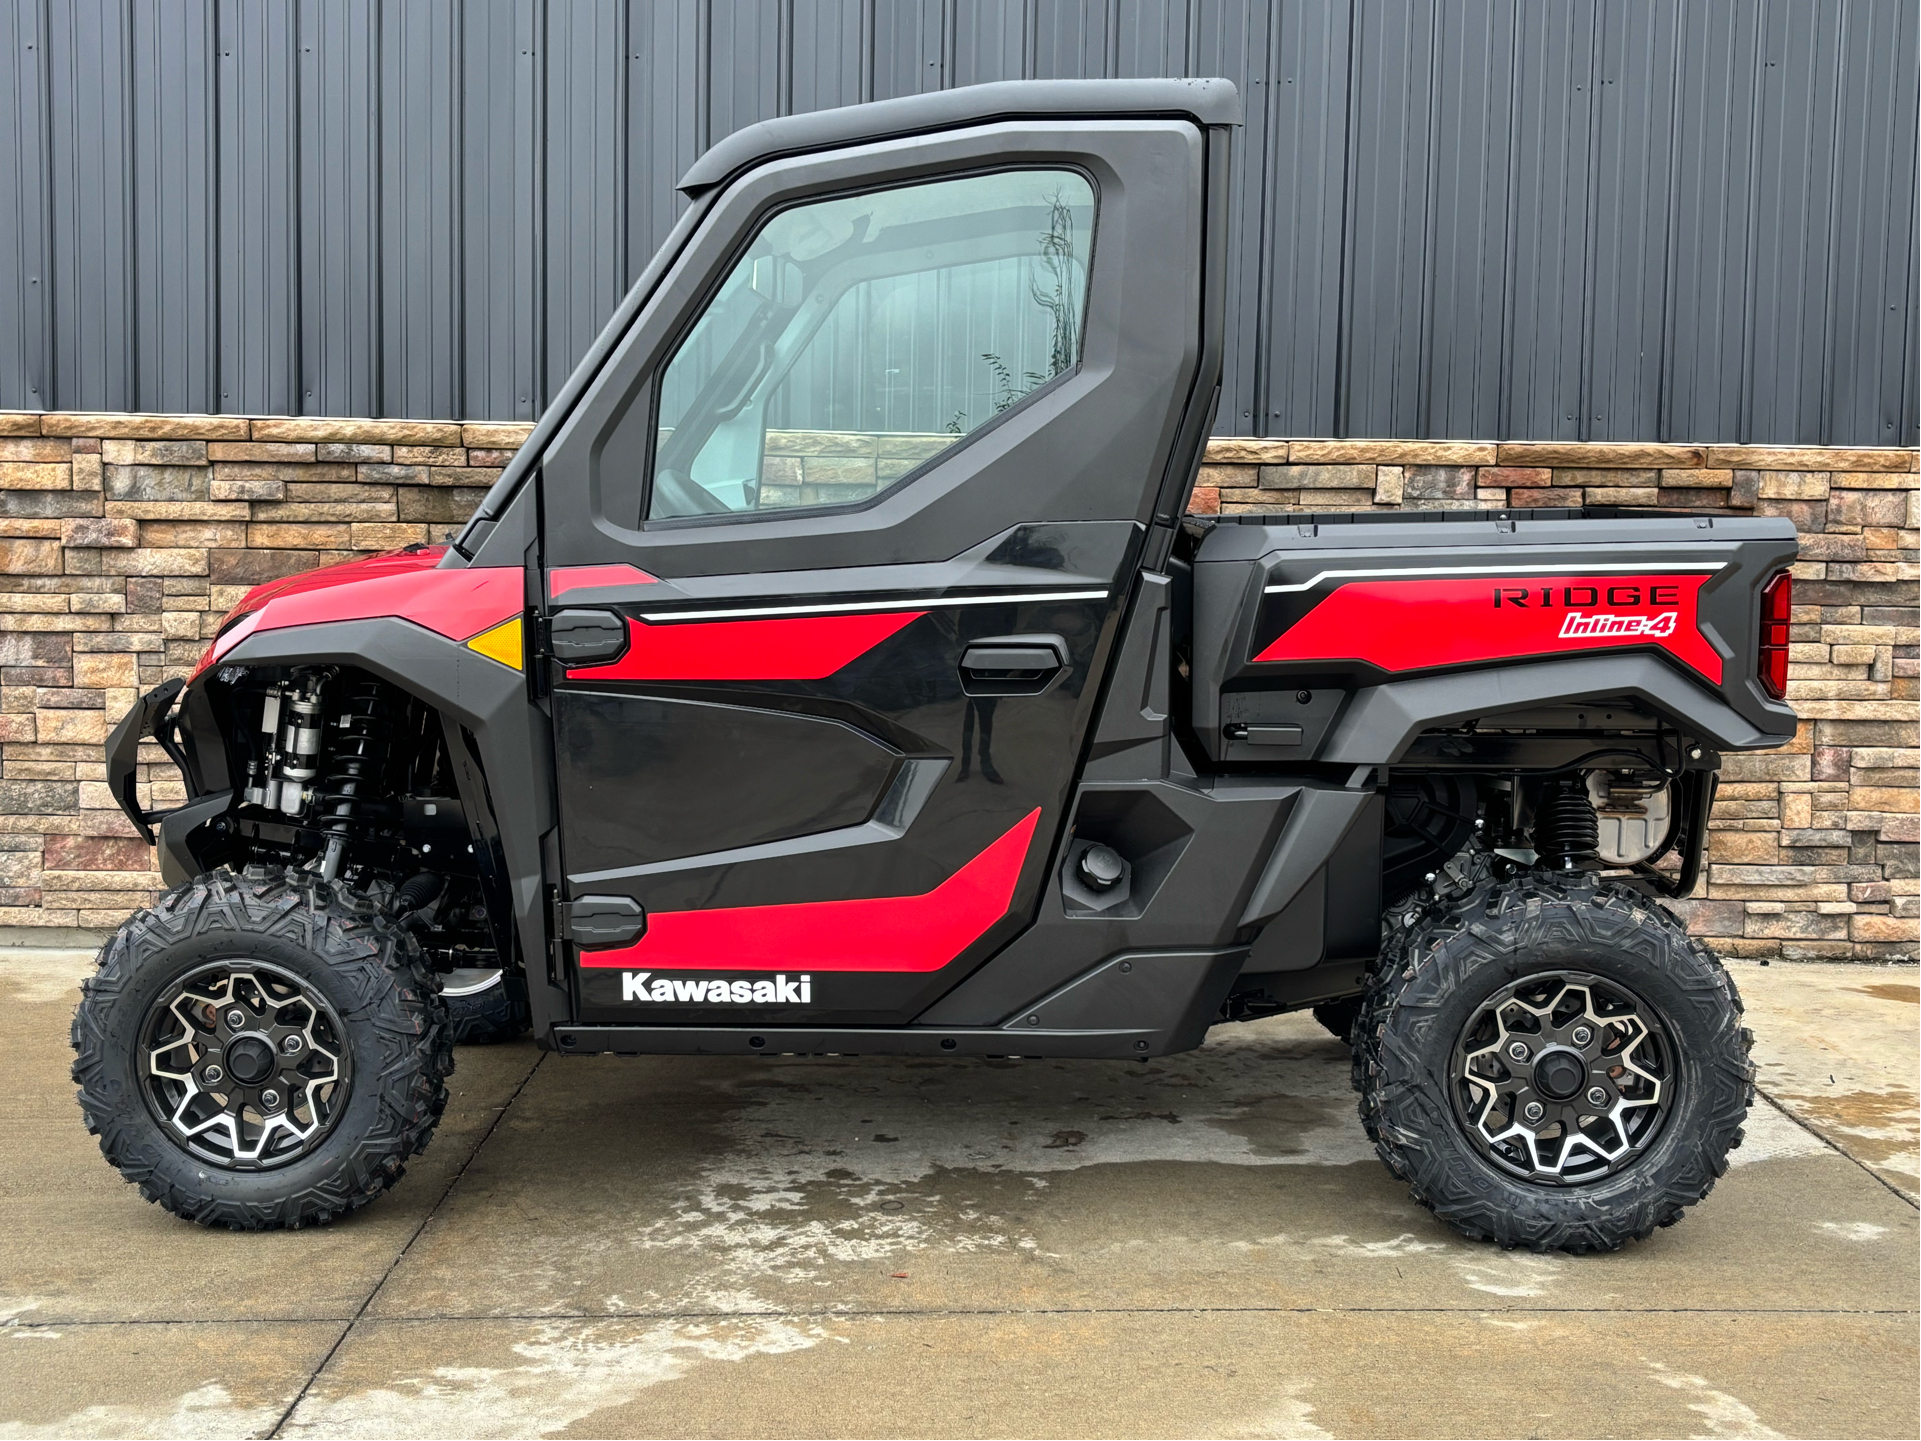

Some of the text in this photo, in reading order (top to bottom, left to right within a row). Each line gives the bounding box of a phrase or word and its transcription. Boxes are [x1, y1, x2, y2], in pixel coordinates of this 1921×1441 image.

[1493, 585, 1680, 609] RIDGE
[1557, 611, 1679, 639] Inline-4
[621, 971, 812, 1004] Kawasaki
